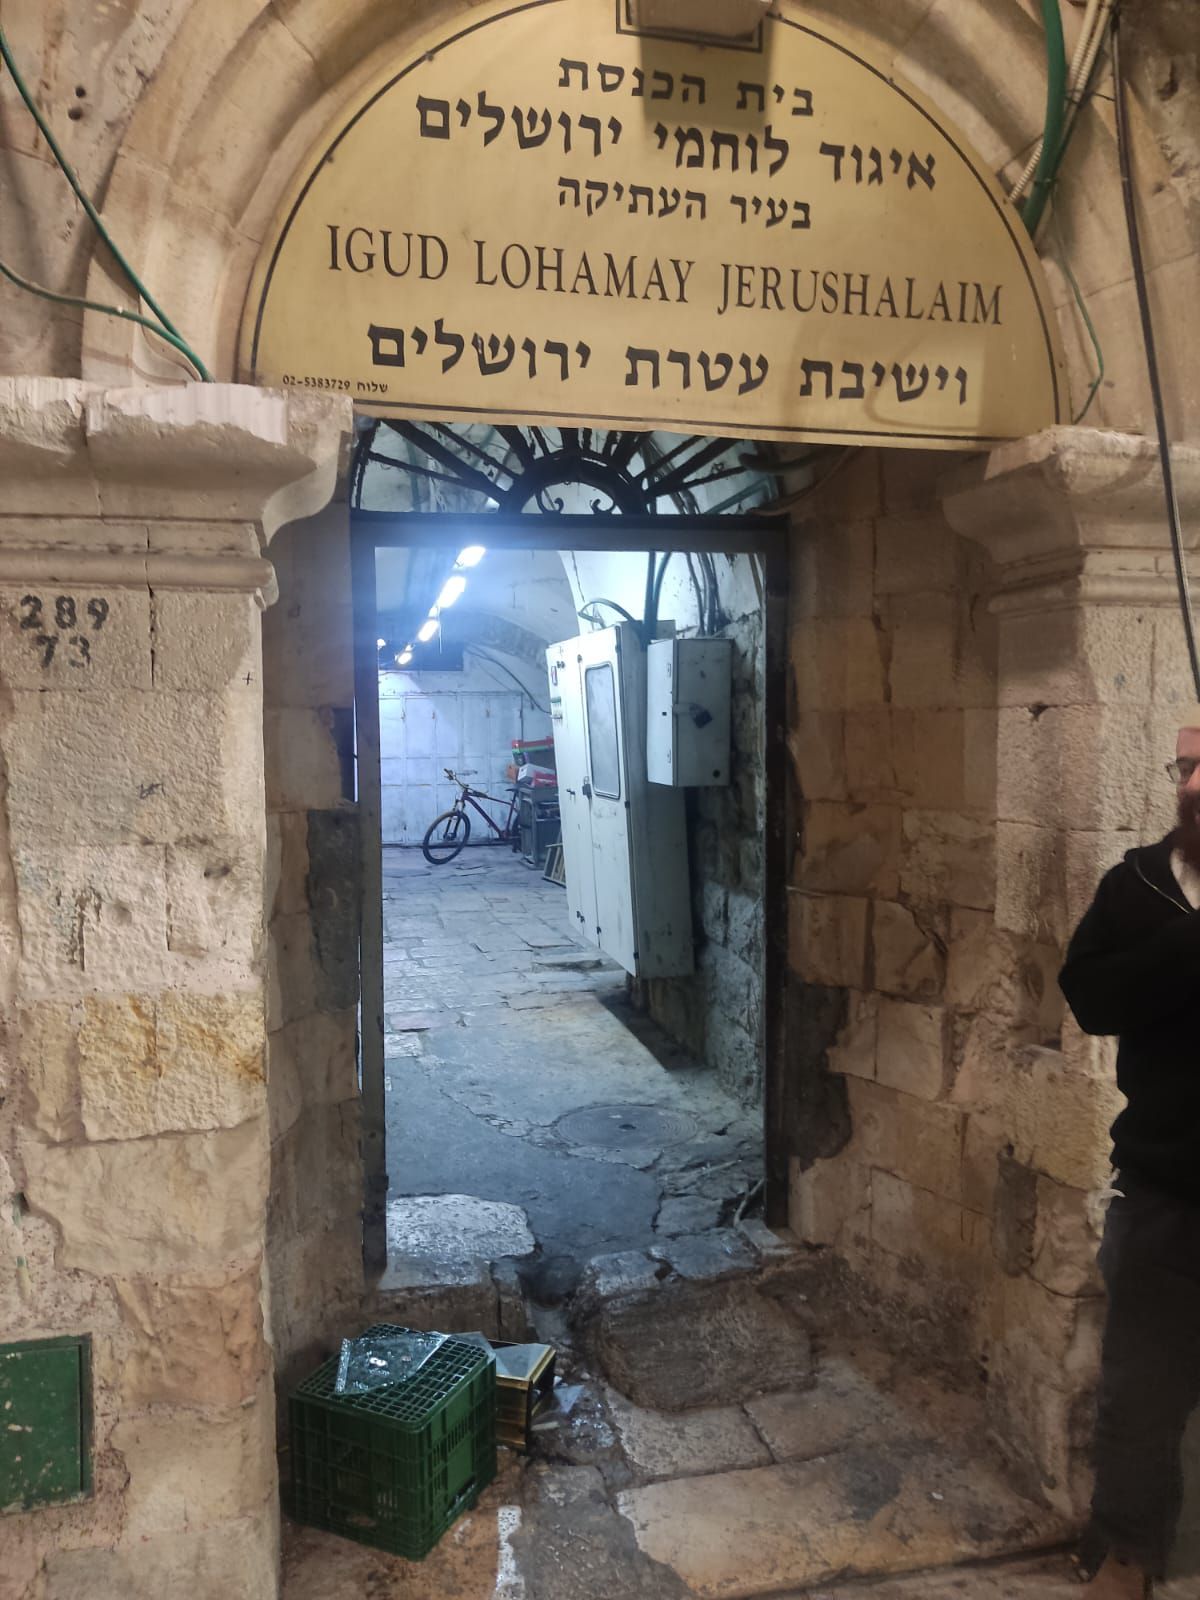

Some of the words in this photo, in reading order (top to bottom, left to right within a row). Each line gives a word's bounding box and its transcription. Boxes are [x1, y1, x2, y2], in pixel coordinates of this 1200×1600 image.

[558, 57, 706, 104] הכנסת
[737, 80, 814, 117] בית
[416, 90, 623, 157] ירושלים
[654, 122, 790, 178] לוחמי
[819, 141, 937, 191] איגוד
[558, 176, 707, 221] העתיקה
[730, 194, 811, 230] בעיר
[326, 224, 449, 281] IGUD
[474, 240, 696, 304] LOHAMAY
[717, 262, 1004, 326] JERUSHALAIM
[367, 318, 592, 381] ירושלים
[625, 345, 769, 396] עטרת
[282, 374, 351, 391] 02-5383729
[356, 381, 389, 393] שלוח
[800, 357, 968, 406] וישיבת
[19, 594, 110, 630] 289
[34, 634, 91, 668] 73
